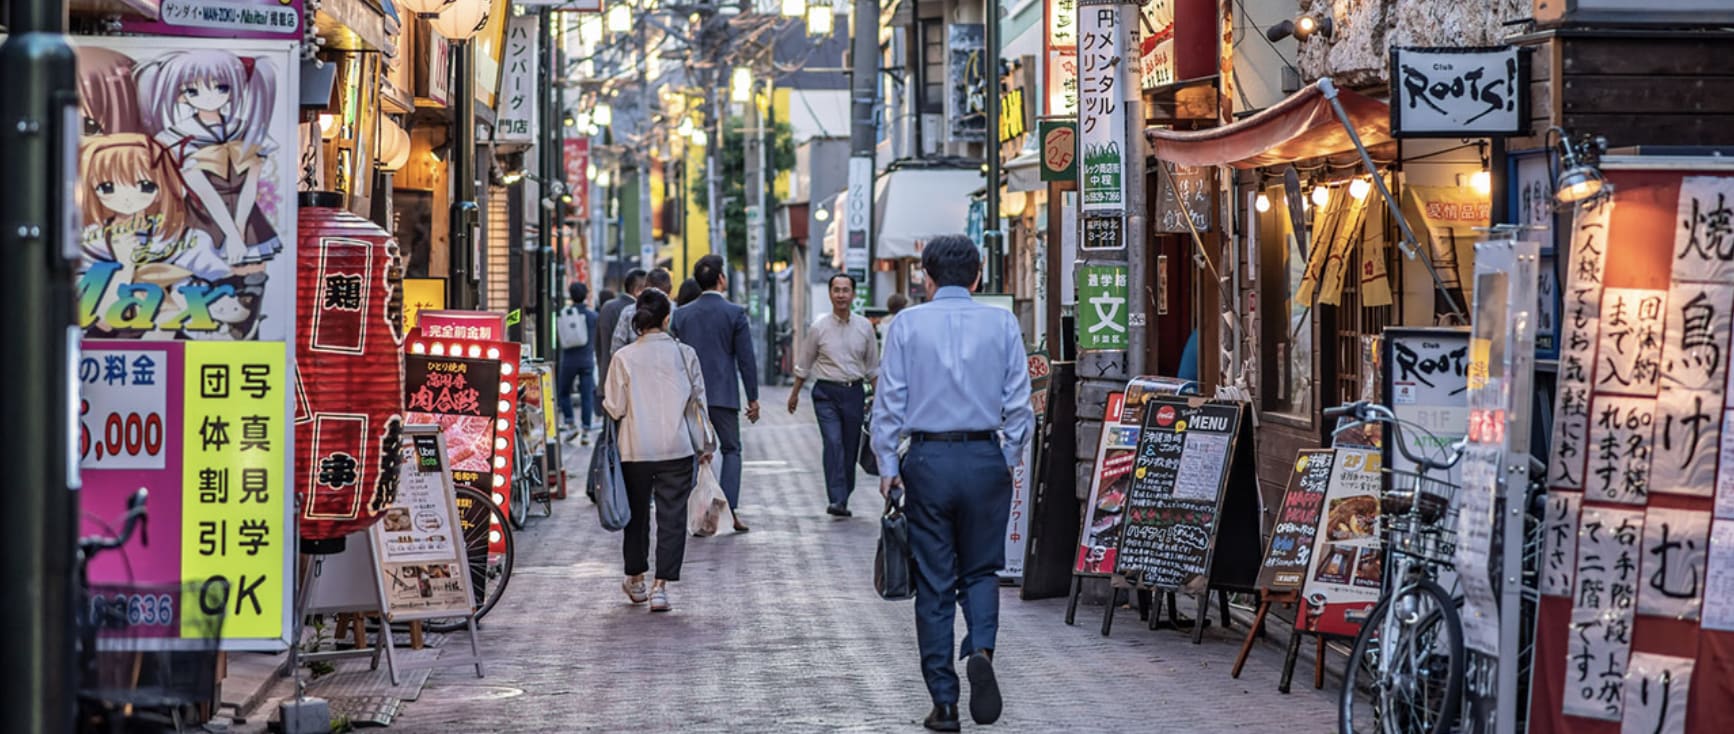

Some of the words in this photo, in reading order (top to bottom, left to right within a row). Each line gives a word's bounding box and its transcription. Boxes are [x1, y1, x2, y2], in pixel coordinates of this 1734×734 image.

[511, 26, 530, 111] ハンバーグ
[1097, 9, 1115, 116] 円メンタル
[1433, 63, 1454, 71] Club
[1084, 32, 1097, 134] クリニック
[1048, 146, 1072, 169] 2F
[852, 184, 864, 227] ZOO
[1088, 231, 1116, 241] 3-22
[1088, 274, 1127, 287] 通学路
[1088, 291, 1126, 333] 文
[79, 354, 156, 386] の料金
[408, 385, 481, 416] 肉合戦
[1188, 415, 1228, 431] MENU
[198, 363, 230, 557] 団体割引
[238, 363, 272, 557] 写真見学
[419, 446, 437, 457] Uber
[421, 459, 439, 467] Eats
[1343, 454, 1361, 468] 2F
[198, 575, 267, 616] OK
